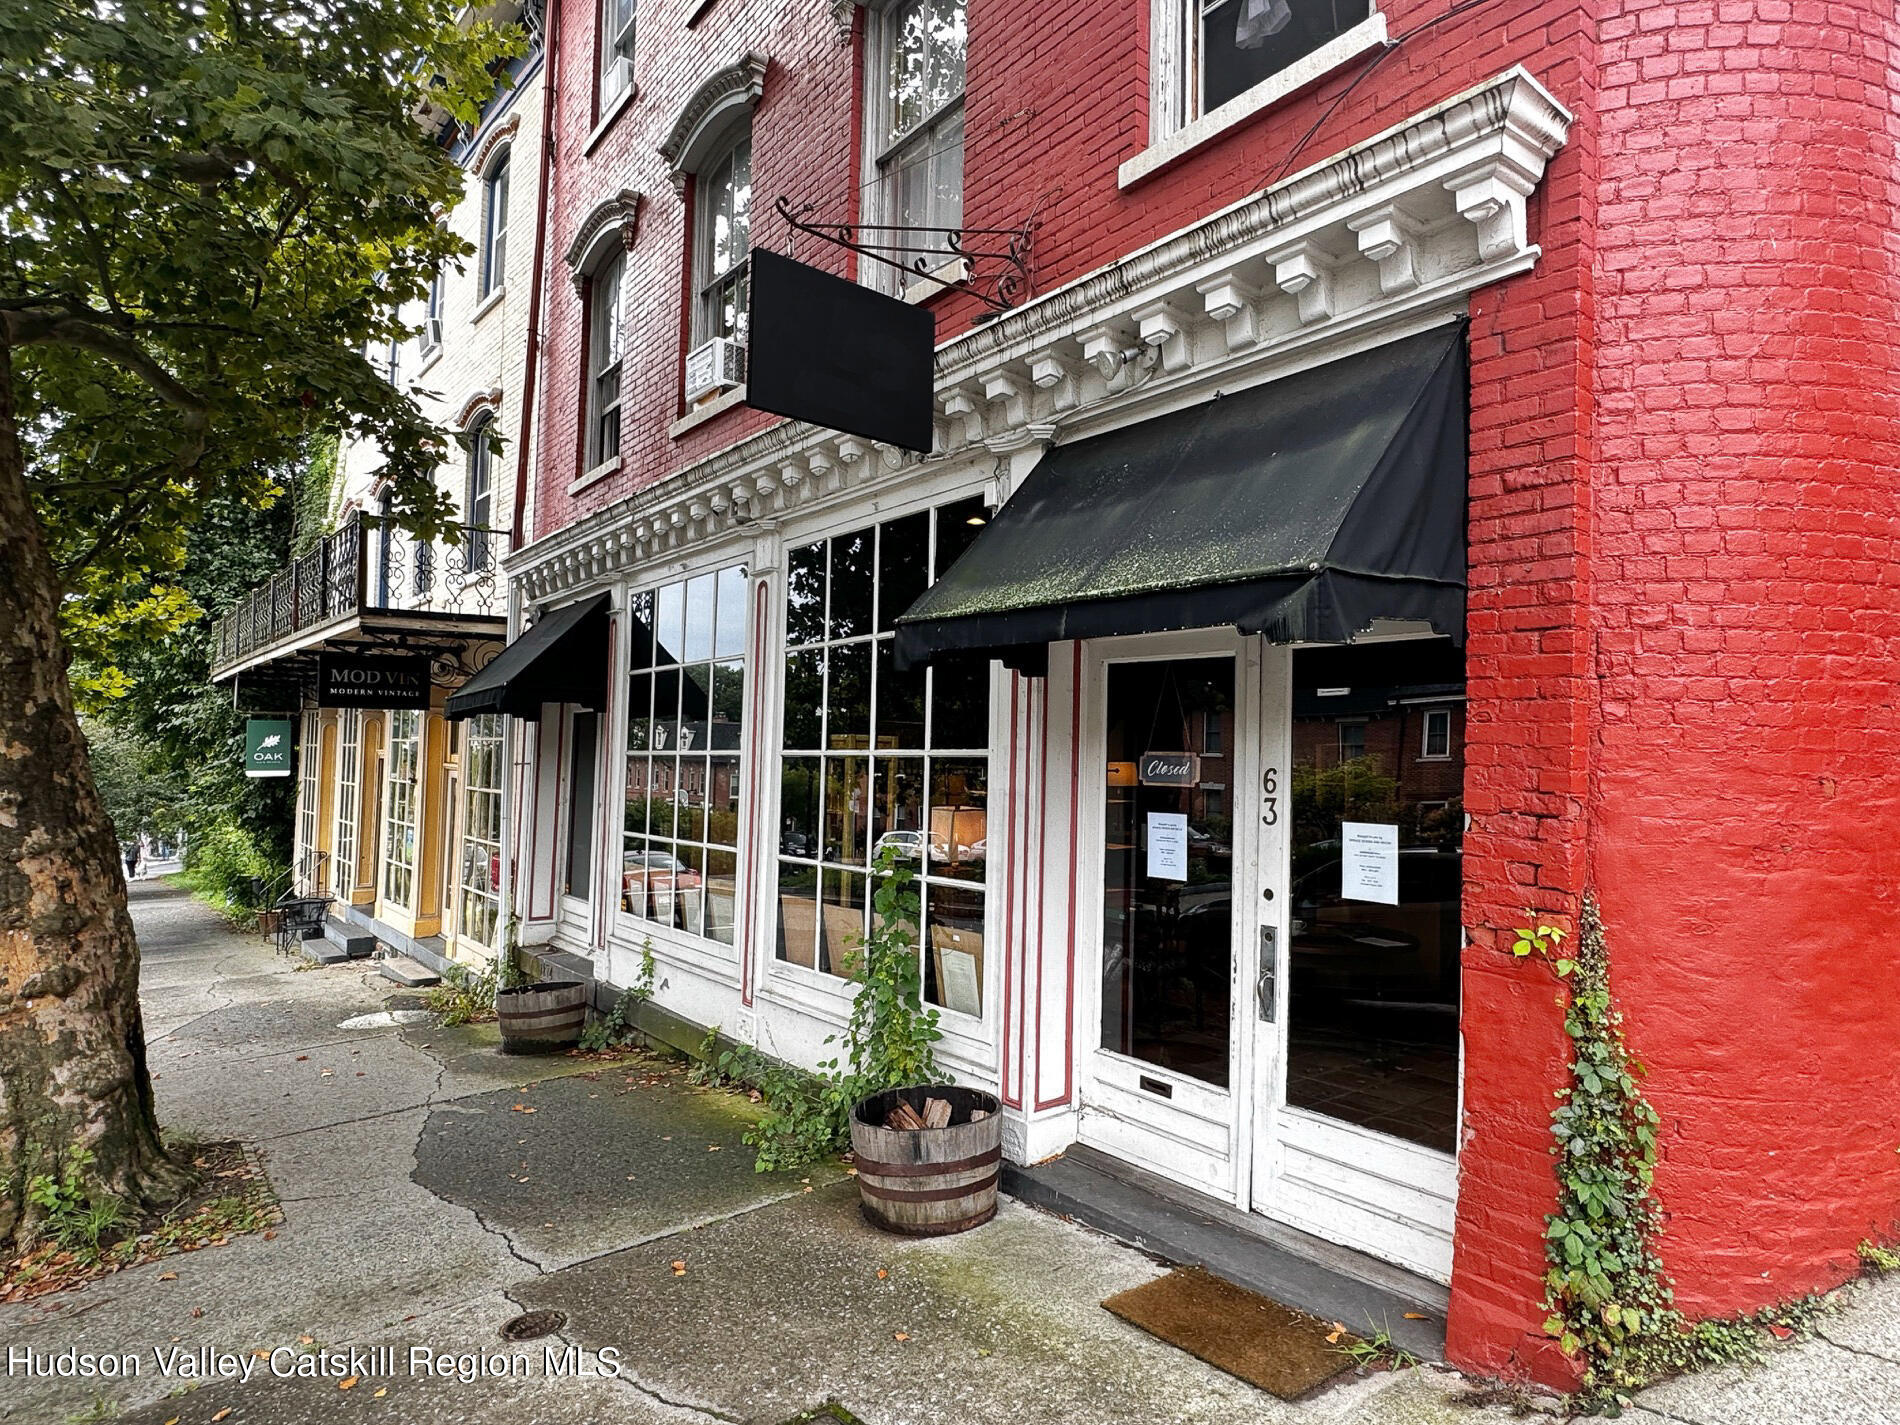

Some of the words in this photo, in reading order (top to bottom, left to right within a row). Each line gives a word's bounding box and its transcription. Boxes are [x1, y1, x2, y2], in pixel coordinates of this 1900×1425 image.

[330, 669, 381, 684] MOD
[330, 687, 373, 696] MODERN
[253, 752, 283, 761] OAK
[1147, 759, 1191, 777] Closed
[1262, 767, 1278, 826] 63
